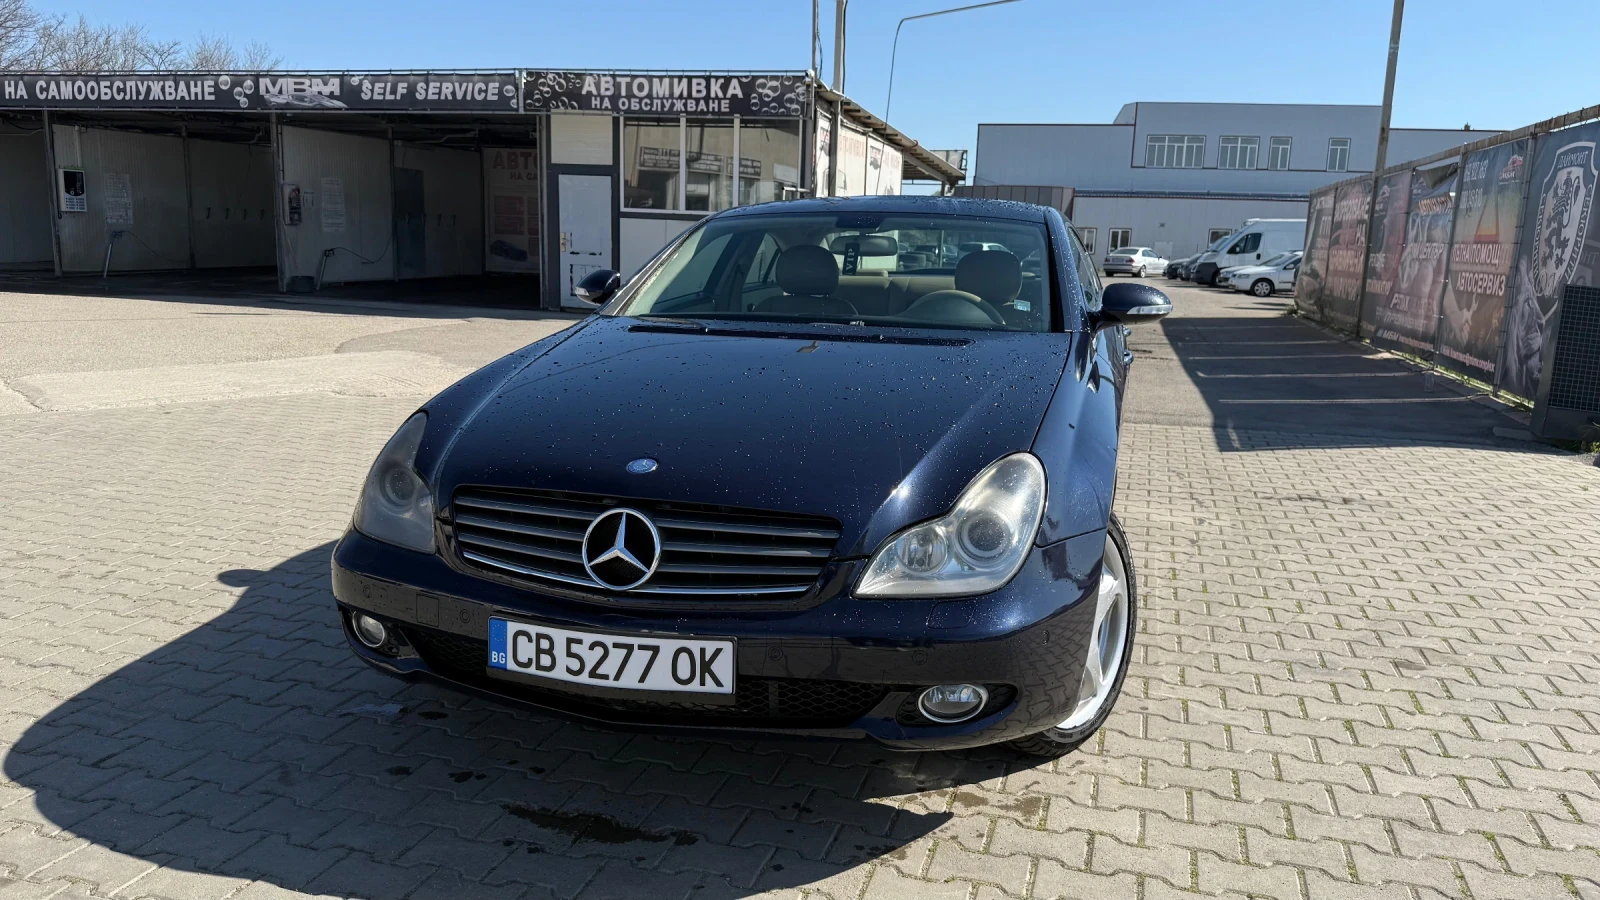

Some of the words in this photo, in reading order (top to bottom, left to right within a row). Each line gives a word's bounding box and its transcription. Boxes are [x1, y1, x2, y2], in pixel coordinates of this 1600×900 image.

[4, 80, 28, 99] НА
[35, 80, 216, 100] САМООБСЛУЖВАНЕ
[361, 82, 408, 100] SELF
[415, 82, 500, 101] SERVICE
[581, 76, 744, 98] АВТОМИВКА
[591, 98, 611, 110] НА
[618, 98, 730, 113] ОБСЛУЖВАНЕ
[493, 150, 538, 170] АВТ
[1456, 272, 1506, 297] АВТОСЕРВИЗ
[491, 651, 506, 664] BG
[512, 629, 556, 673] CB
[565, 637, 660, 684] 5277
[671, 646, 724, 688] OK
